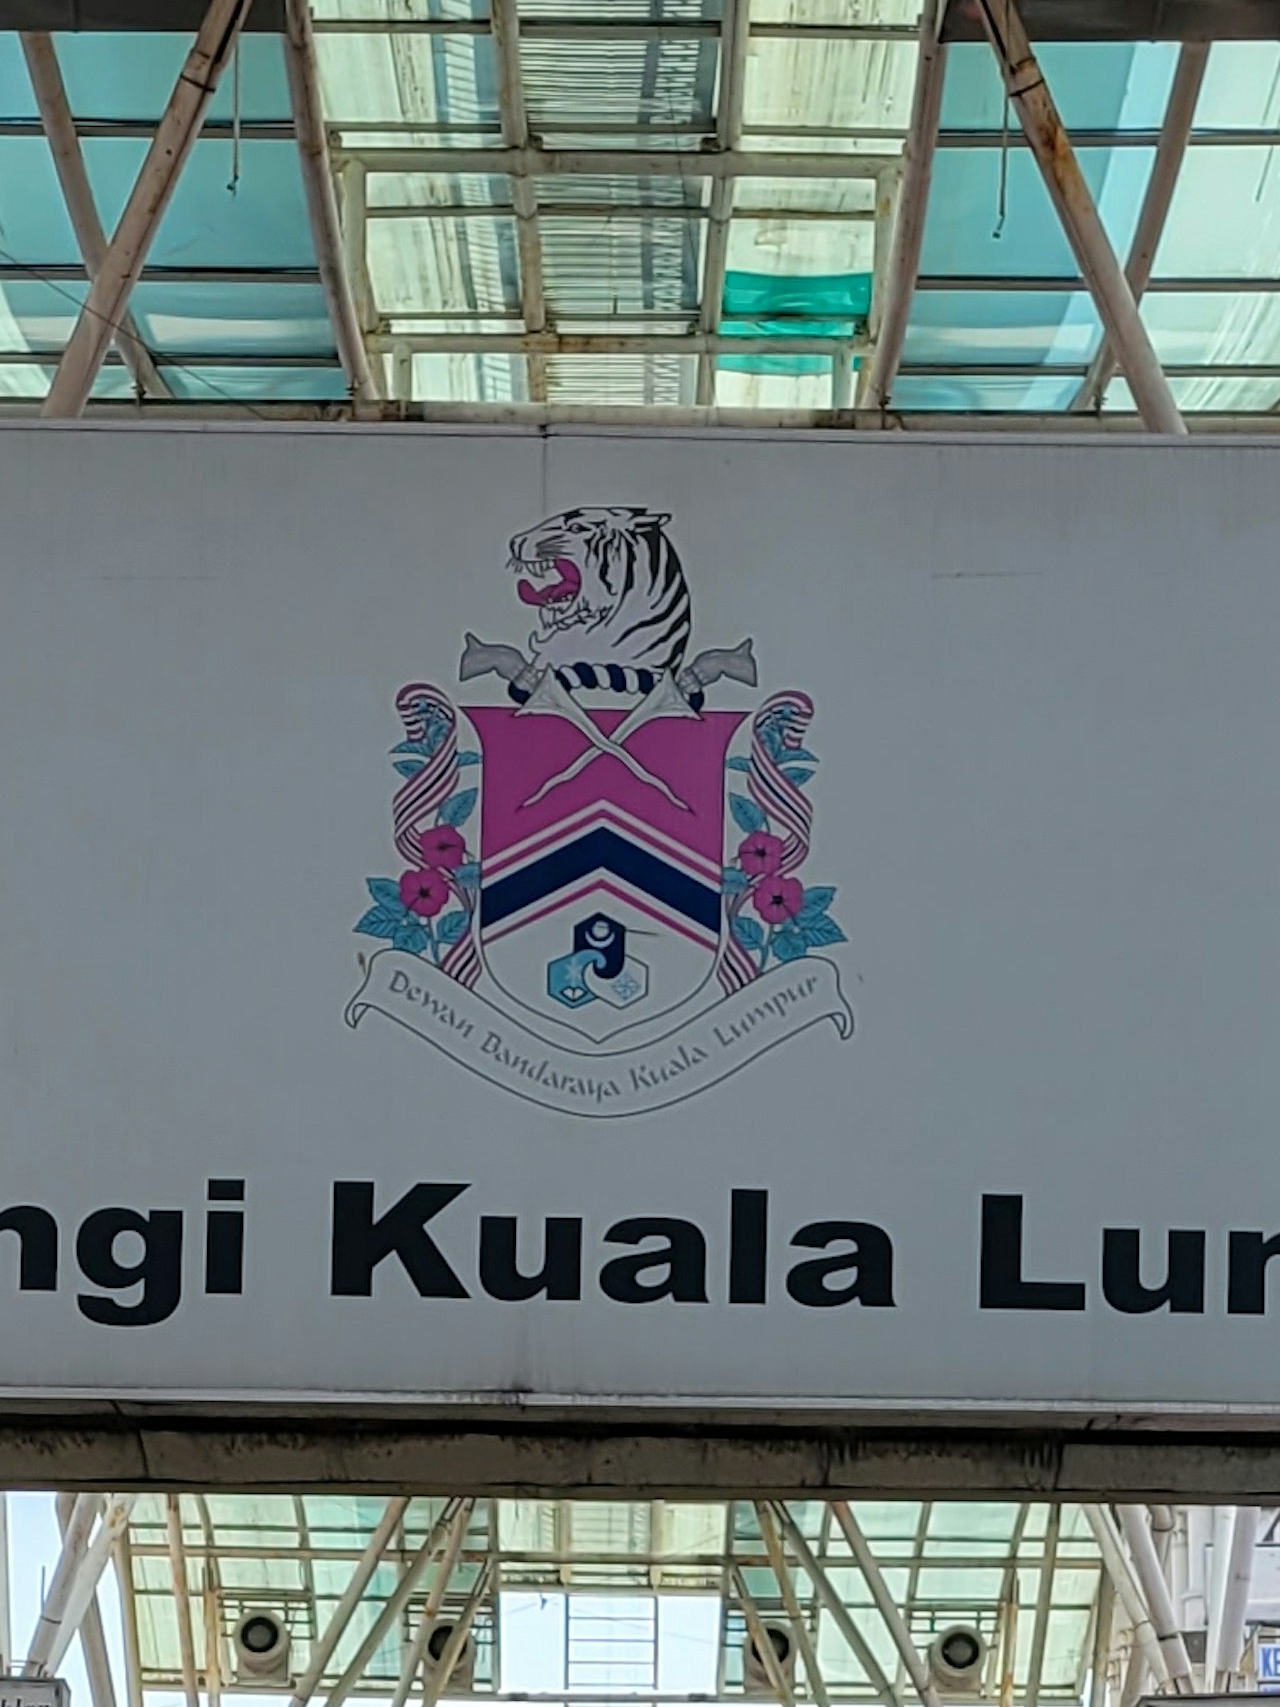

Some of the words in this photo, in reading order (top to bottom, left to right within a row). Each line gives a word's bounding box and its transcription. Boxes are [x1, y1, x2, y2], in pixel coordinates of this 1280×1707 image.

[389, 966, 475, 1040] Dewan
[629, 1043, 708, 1096] Kuala
[716, 973, 820, 1049] Lumpur
[330, 1181, 895, 1309] Kuala
